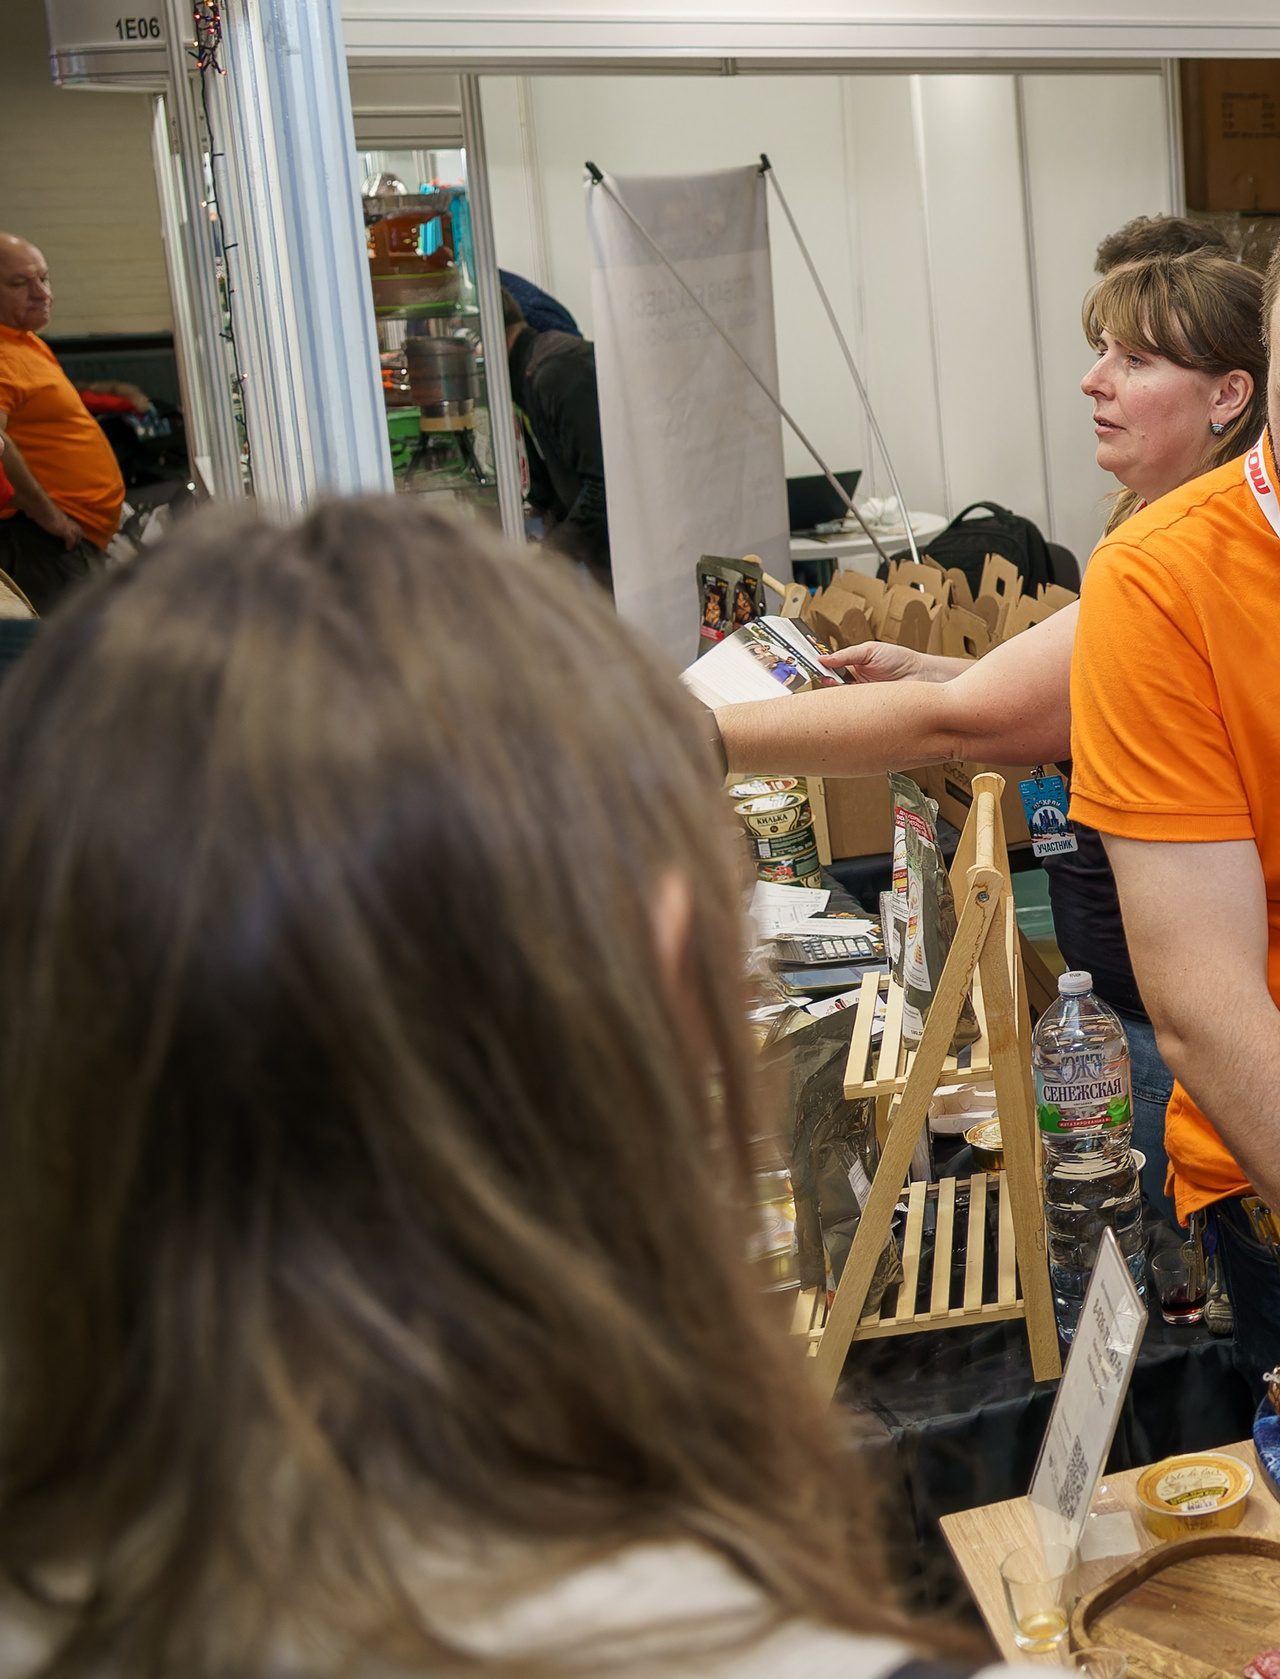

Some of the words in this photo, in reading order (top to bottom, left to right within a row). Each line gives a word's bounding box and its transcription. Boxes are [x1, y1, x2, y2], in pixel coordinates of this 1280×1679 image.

[115, 16, 161, 41] 1E06
[756, 813, 789, 825] КИЛЬКА
[1036, 839, 1074, 854] УЧАСТНИК
[1043, 1078, 1123, 1102] СЕНЕЖСКАЯ
